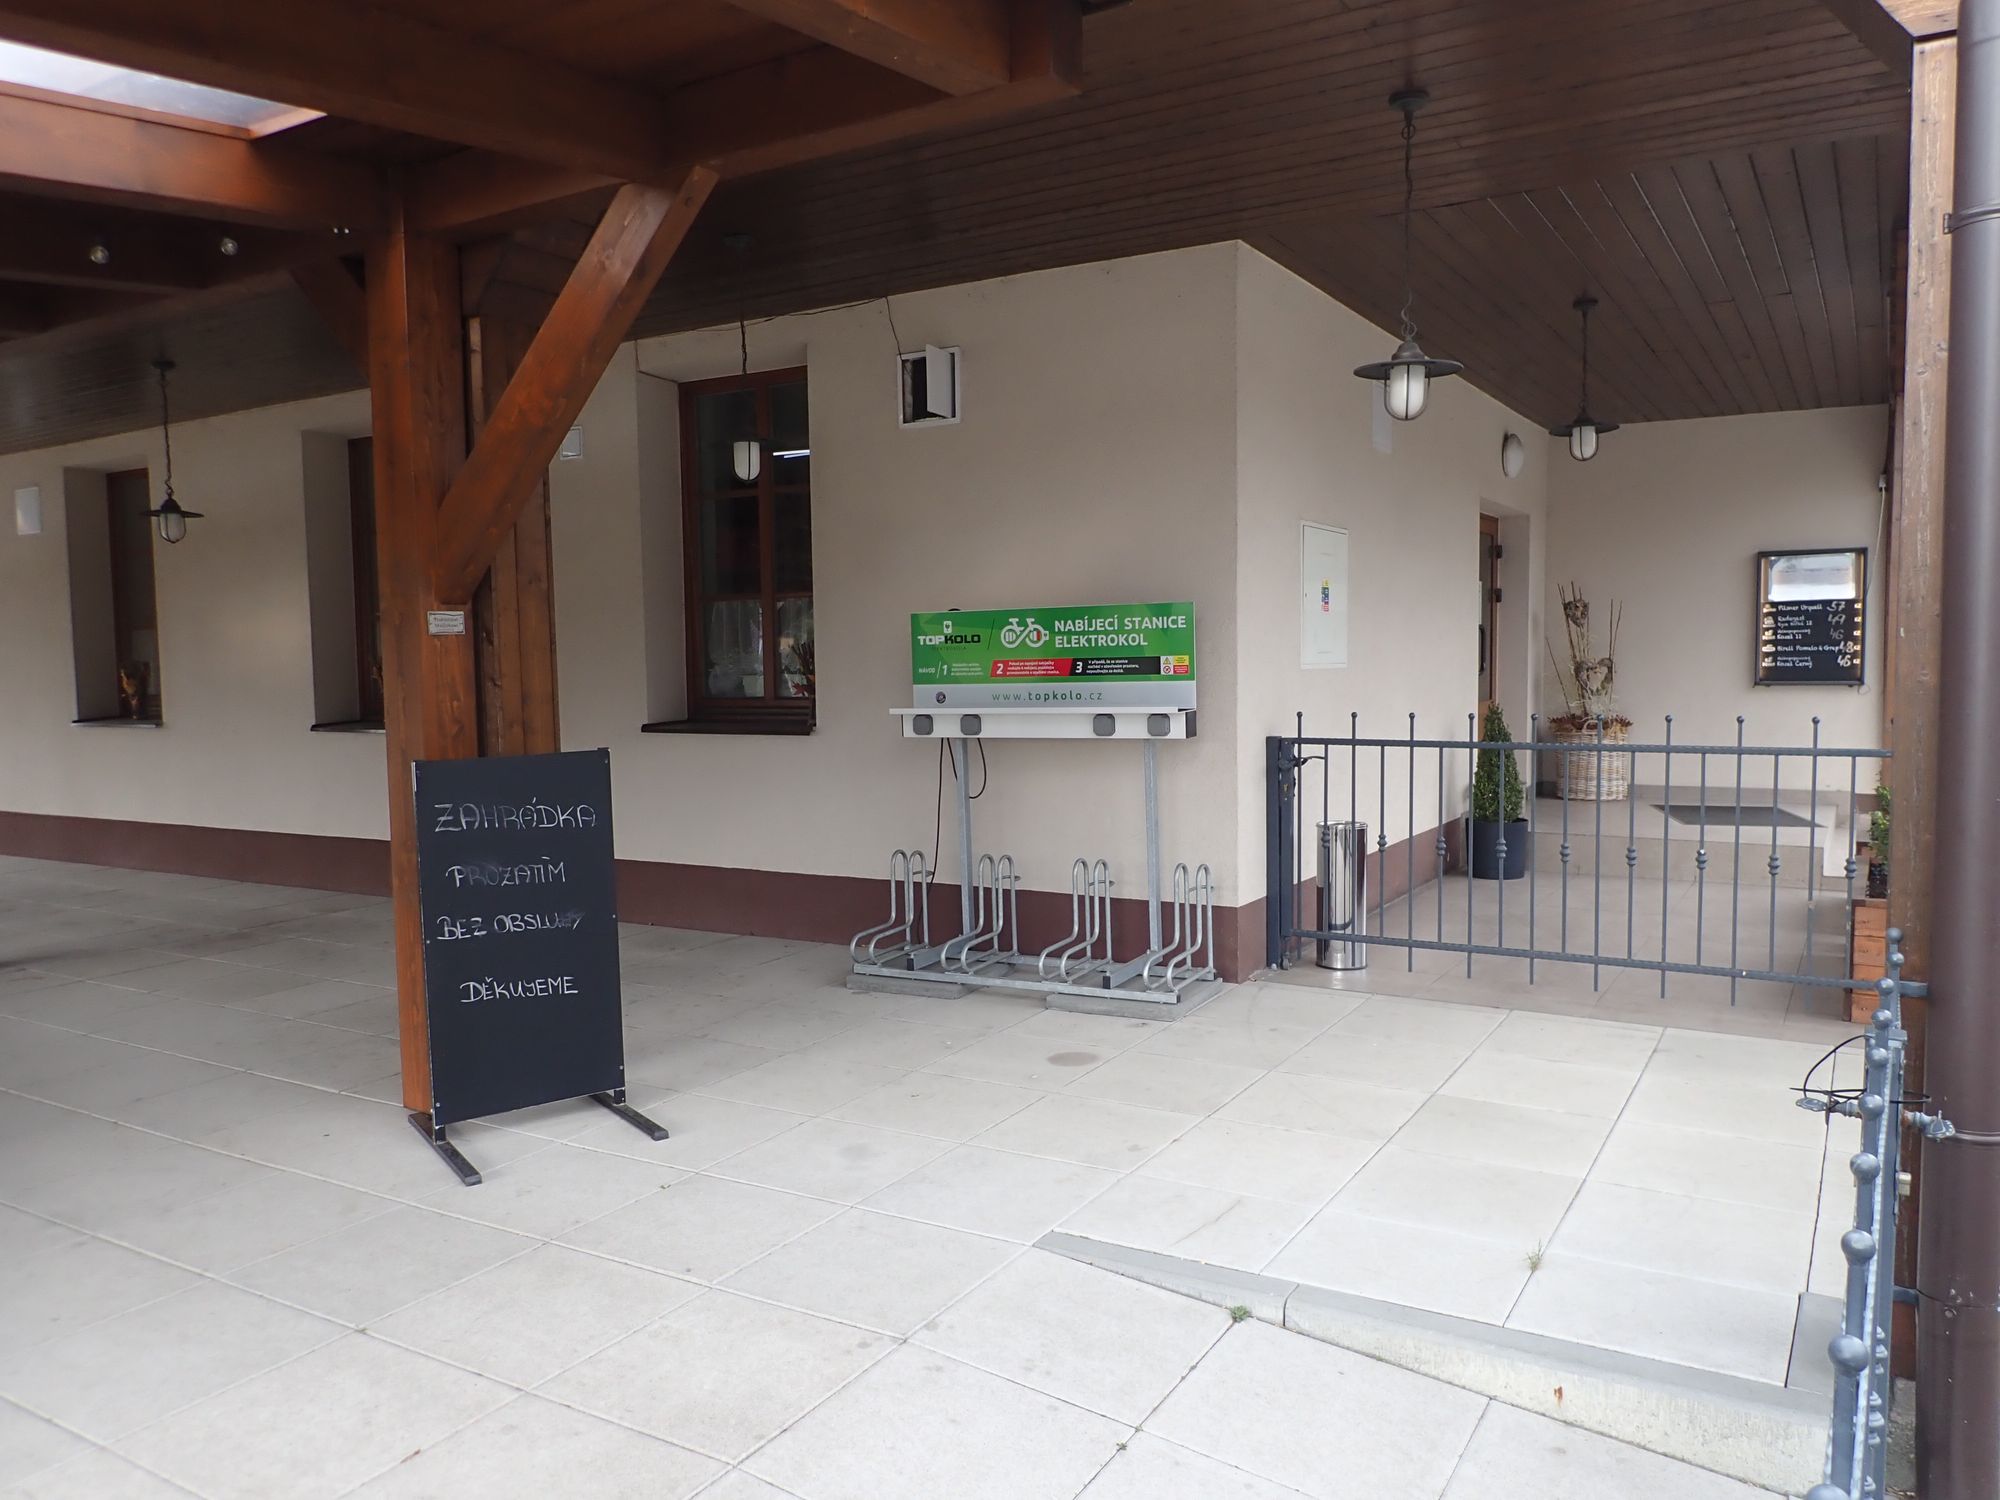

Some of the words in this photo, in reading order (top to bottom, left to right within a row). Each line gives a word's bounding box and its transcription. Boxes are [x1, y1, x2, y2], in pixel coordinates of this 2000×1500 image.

[1826, 601, 1846, 611] 57
[1054, 615, 1118, 632] NABÍJECÍ
[1124, 615, 1187, 630] STANICE
[1827, 613, 1846, 625] 49
[917, 634, 981, 646] TOPKOLO
[1830, 628, 1844, 640] 46
[1055, 633, 1148, 648] ELEKTROKOL
[1075, 661, 1083, 673] 3
[1837, 655, 1851, 667] 46
[942, 664, 948, 676] 1
[996, 663, 1004, 675] 2
[992, 690, 1103, 702] www.topkolo.cz
[434, 797, 597, 832] ZAHRÁDKA
[446, 856, 566, 887] PROZATÍM
[436, 916, 487, 940] BEZ
[459, 976, 578, 1002] DĚKUJEME
